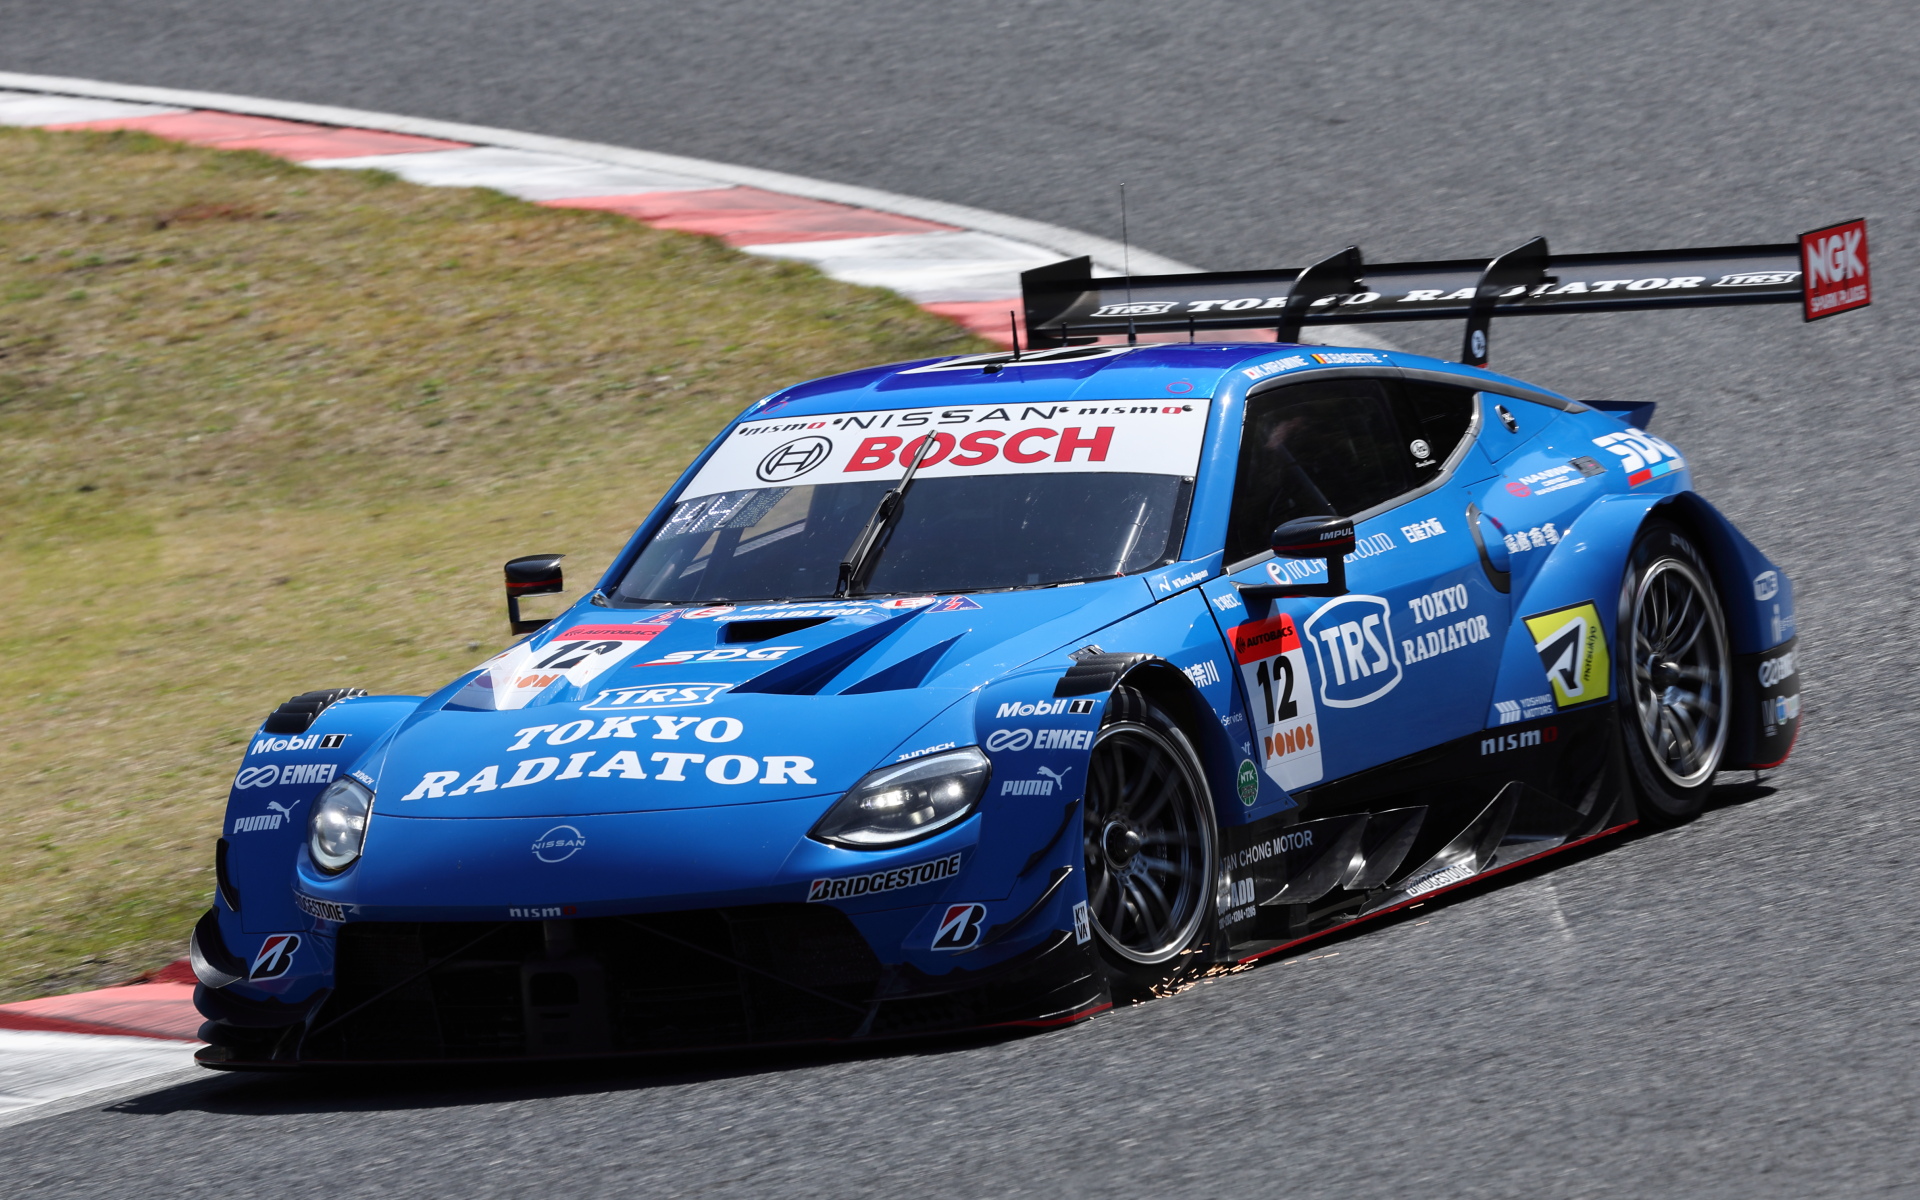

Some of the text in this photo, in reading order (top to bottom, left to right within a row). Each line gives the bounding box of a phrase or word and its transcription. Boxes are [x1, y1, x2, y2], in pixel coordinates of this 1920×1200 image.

[1806, 228, 1865, 289] NGK
[1731, 273, 1783, 285] TRS
[840, 406, 1056, 431] NISSAN
[1079, 405, 1183, 416] nismo
[746, 421, 826, 436] nismo
[843, 425, 1116, 474] BOSCH
[1319, 527, 1354, 541] IMPUL
[819, 608, 873, 616] 1201
[1408, 583, 1469, 625] TOKYO
[1246, 625, 1294, 649] AUTOBACS
[1401, 614, 1492, 666] RADIATOR
[533, 641, 624, 669] 12
[645, 646, 804, 664] SDG
[1320, 613, 1390, 686] TRS
[610, 686, 710, 705] TRS
[1257, 655, 1298, 725] 12
[995, 699, 1064, 718] Mobil
[506, 715, 743, 752] TOKYO
[1033, 729, 1094, 750] ENKEI
[1264, 723, 1314, 760] PONOS
[1481, 726, 1558, 756] nismo
[251, 734, 320, 755] Mobil
[896, 742, 956, 762] JUNACK
[279, 764, 337, 785] ENKEI
[401, 750, 817, 801] RADIATOR
[1240, 770, 1254, 784] NTK
[1001, 780, 1054, 796] PUMA
[233, 814, 282, 833] PUMA
[531, 839, 586, 850] NISSAN
[1223, 830, 1313, 871] TAN CHONG MOTOR
[807, 852, 961, 902] BRIDGESTONE
[509, 905, 577, 917] nismo
